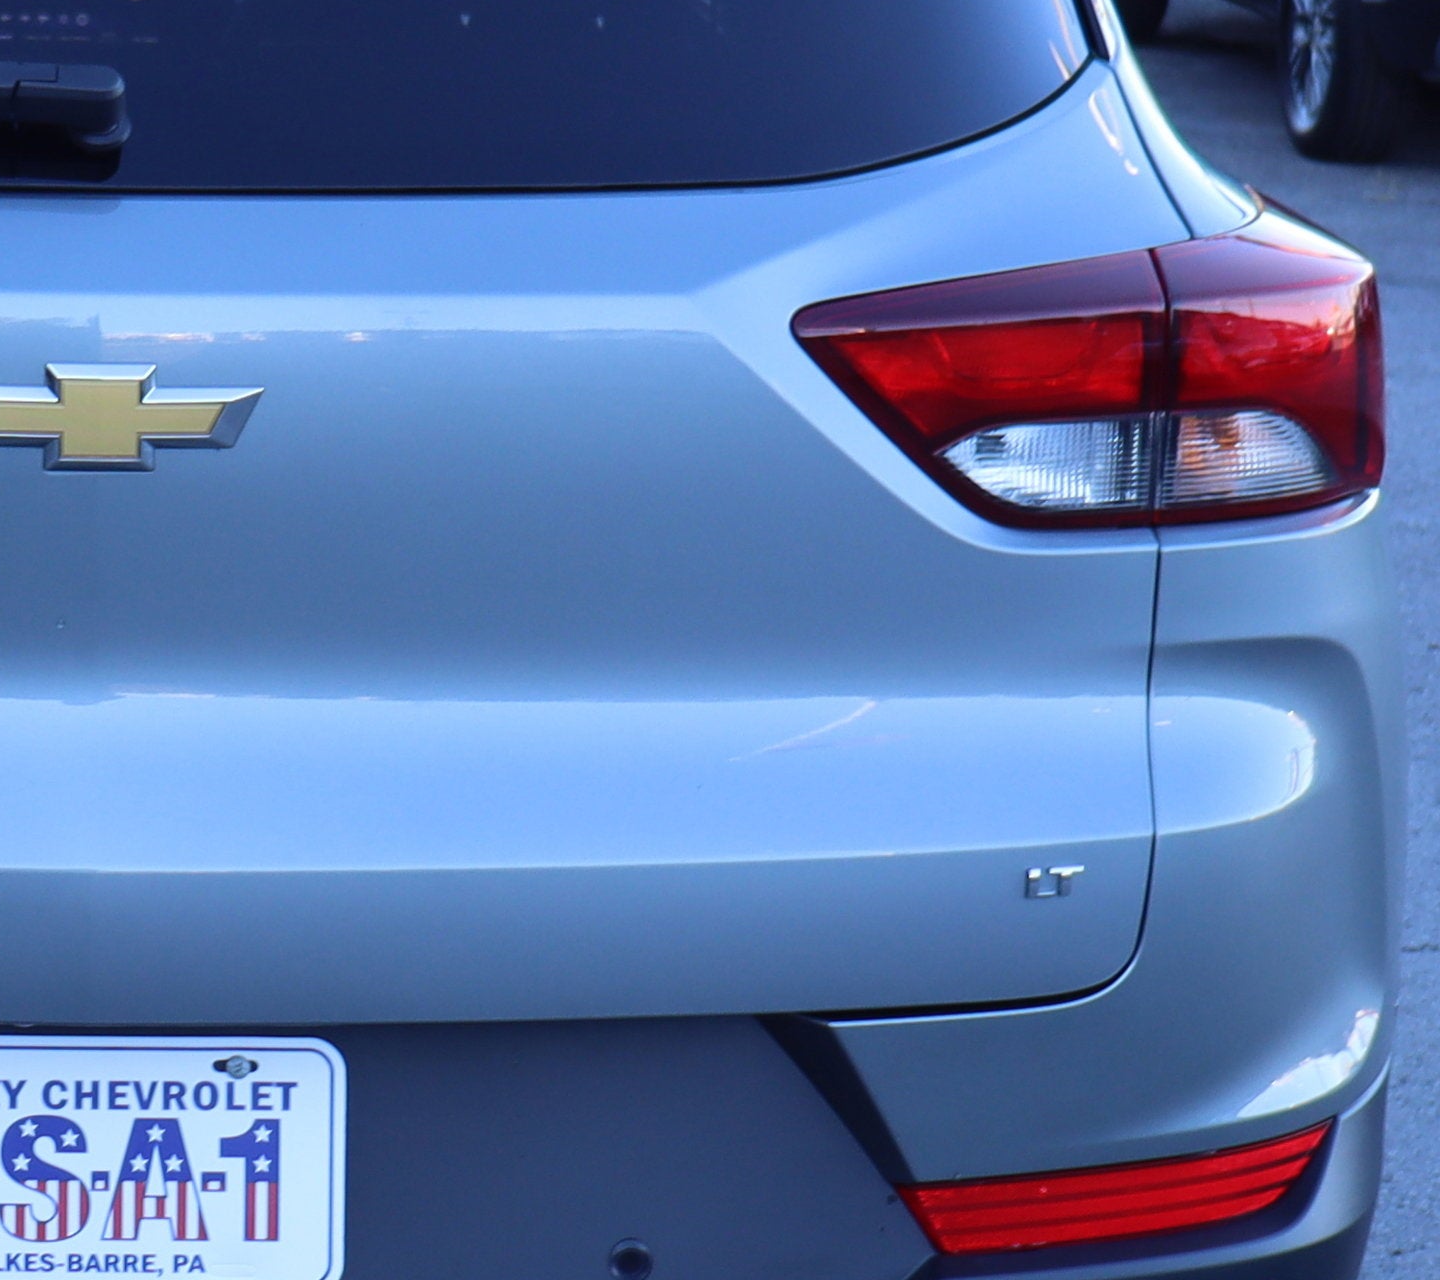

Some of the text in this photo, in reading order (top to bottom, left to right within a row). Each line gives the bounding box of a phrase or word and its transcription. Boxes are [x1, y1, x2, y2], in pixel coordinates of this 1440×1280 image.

[1024, 865, 1085, 899] LT
[42, 1080, 298, 1112] CHEVROLET
[171, 1254, 207, 1275] PA
